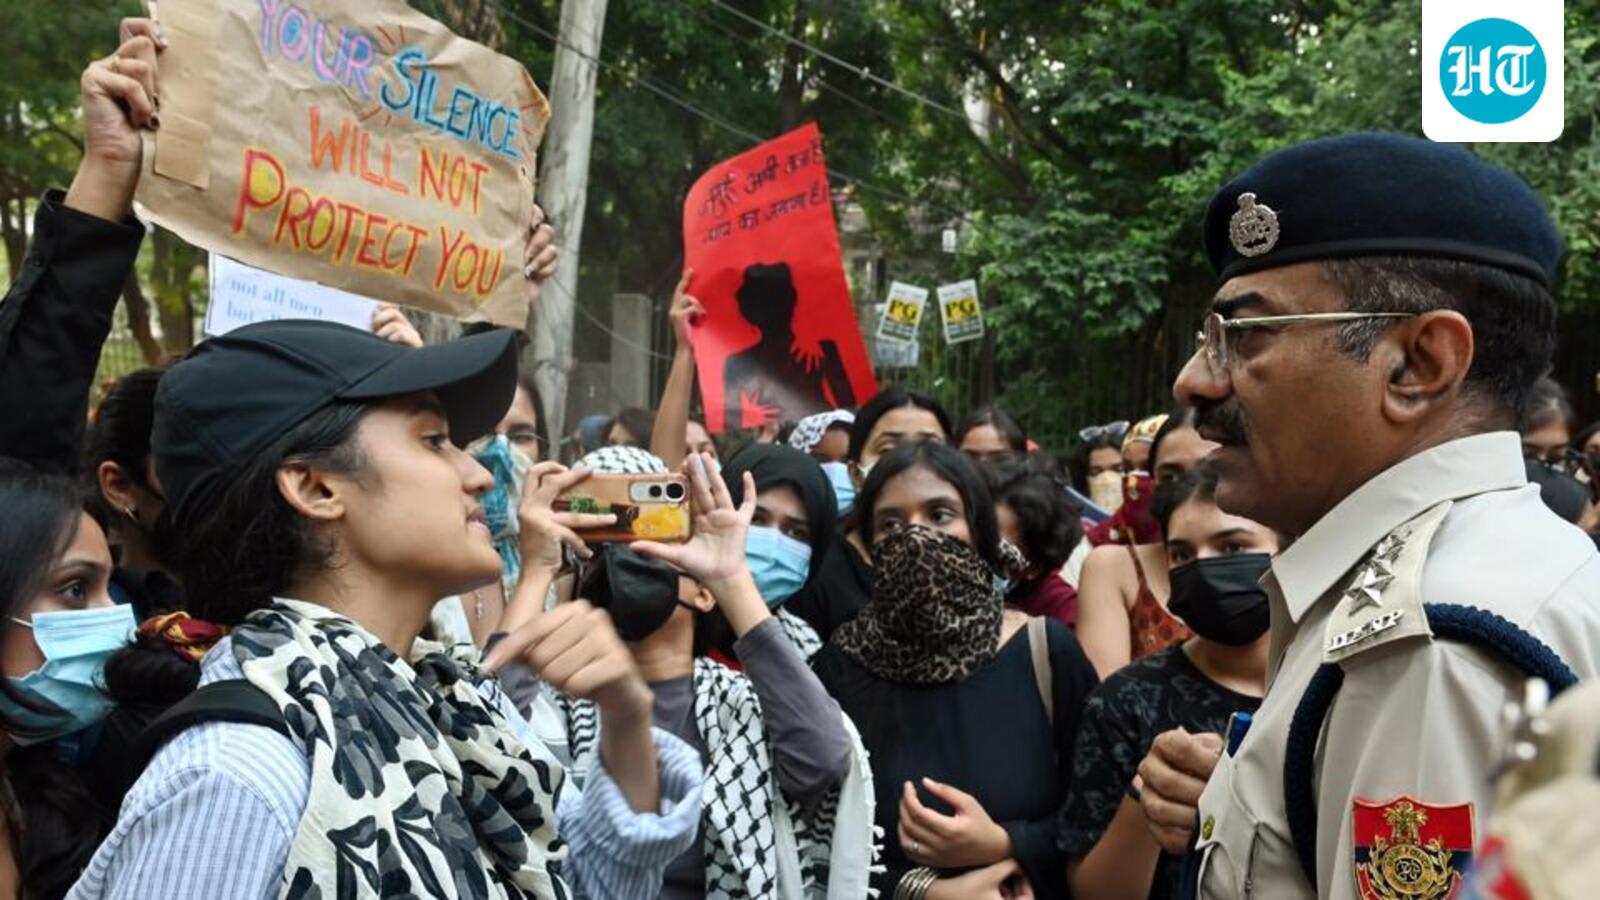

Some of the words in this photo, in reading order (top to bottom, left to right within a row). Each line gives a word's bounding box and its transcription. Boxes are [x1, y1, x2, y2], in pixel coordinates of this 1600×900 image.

[258, 0, 373, 98] YOUR
[379, 46, 522, 159] SILENCE
[233, 147, 427, 277] PROTECT
[434, 226, 503, 297] YOU
[309, 106, 408, 194] WILL
[420, 146, 490, 213] NOT
[231, 279, 257, 298] not
[264, 286, 286, 305] all
